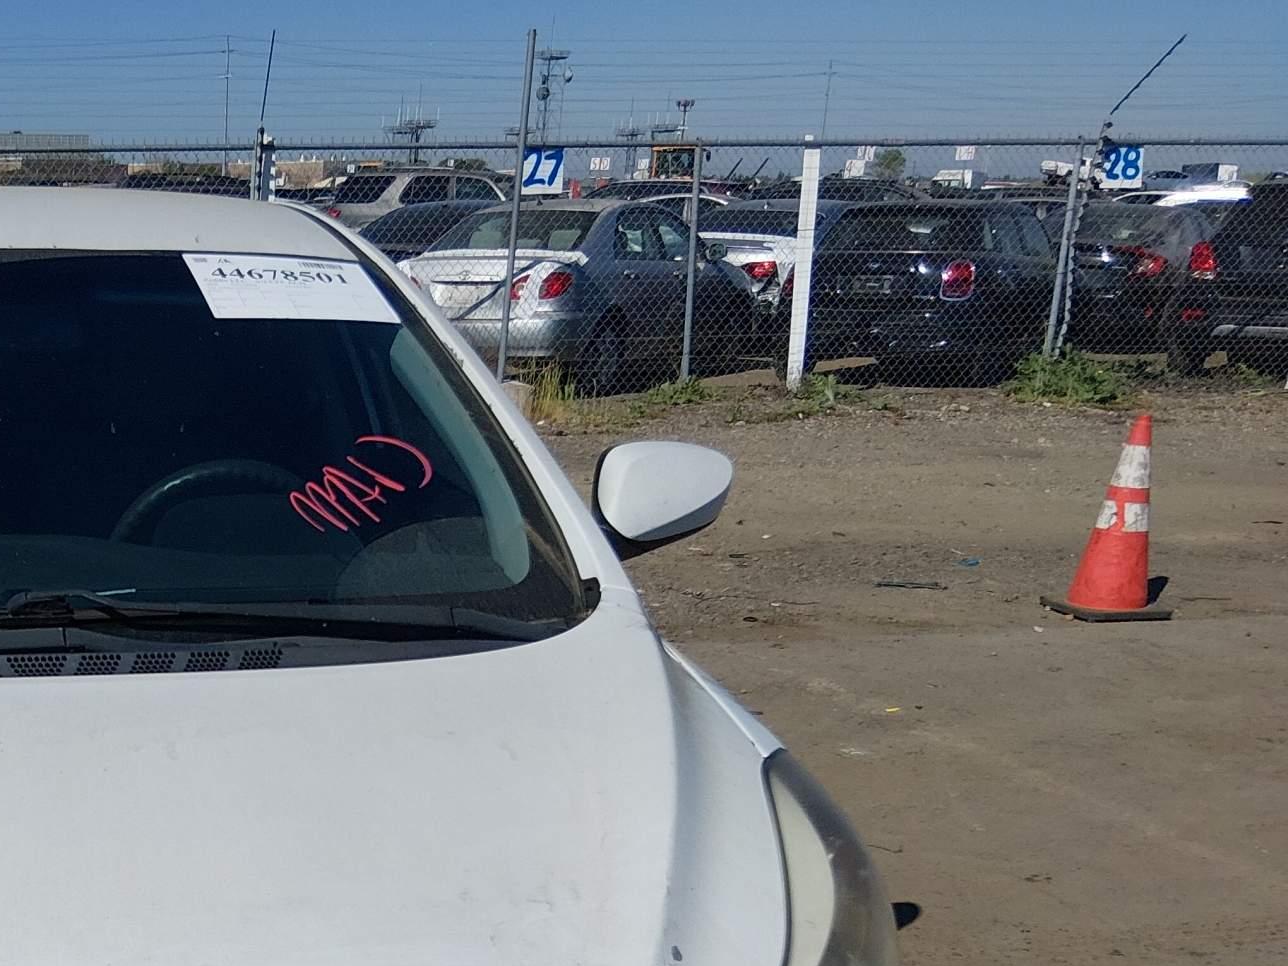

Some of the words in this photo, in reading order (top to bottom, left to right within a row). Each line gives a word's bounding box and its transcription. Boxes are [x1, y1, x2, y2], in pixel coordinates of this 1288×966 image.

[522, 148, 564, 188] 27
[1104, 144, 1141, 181] 28
[210, 266, 348, 284] 44678501
